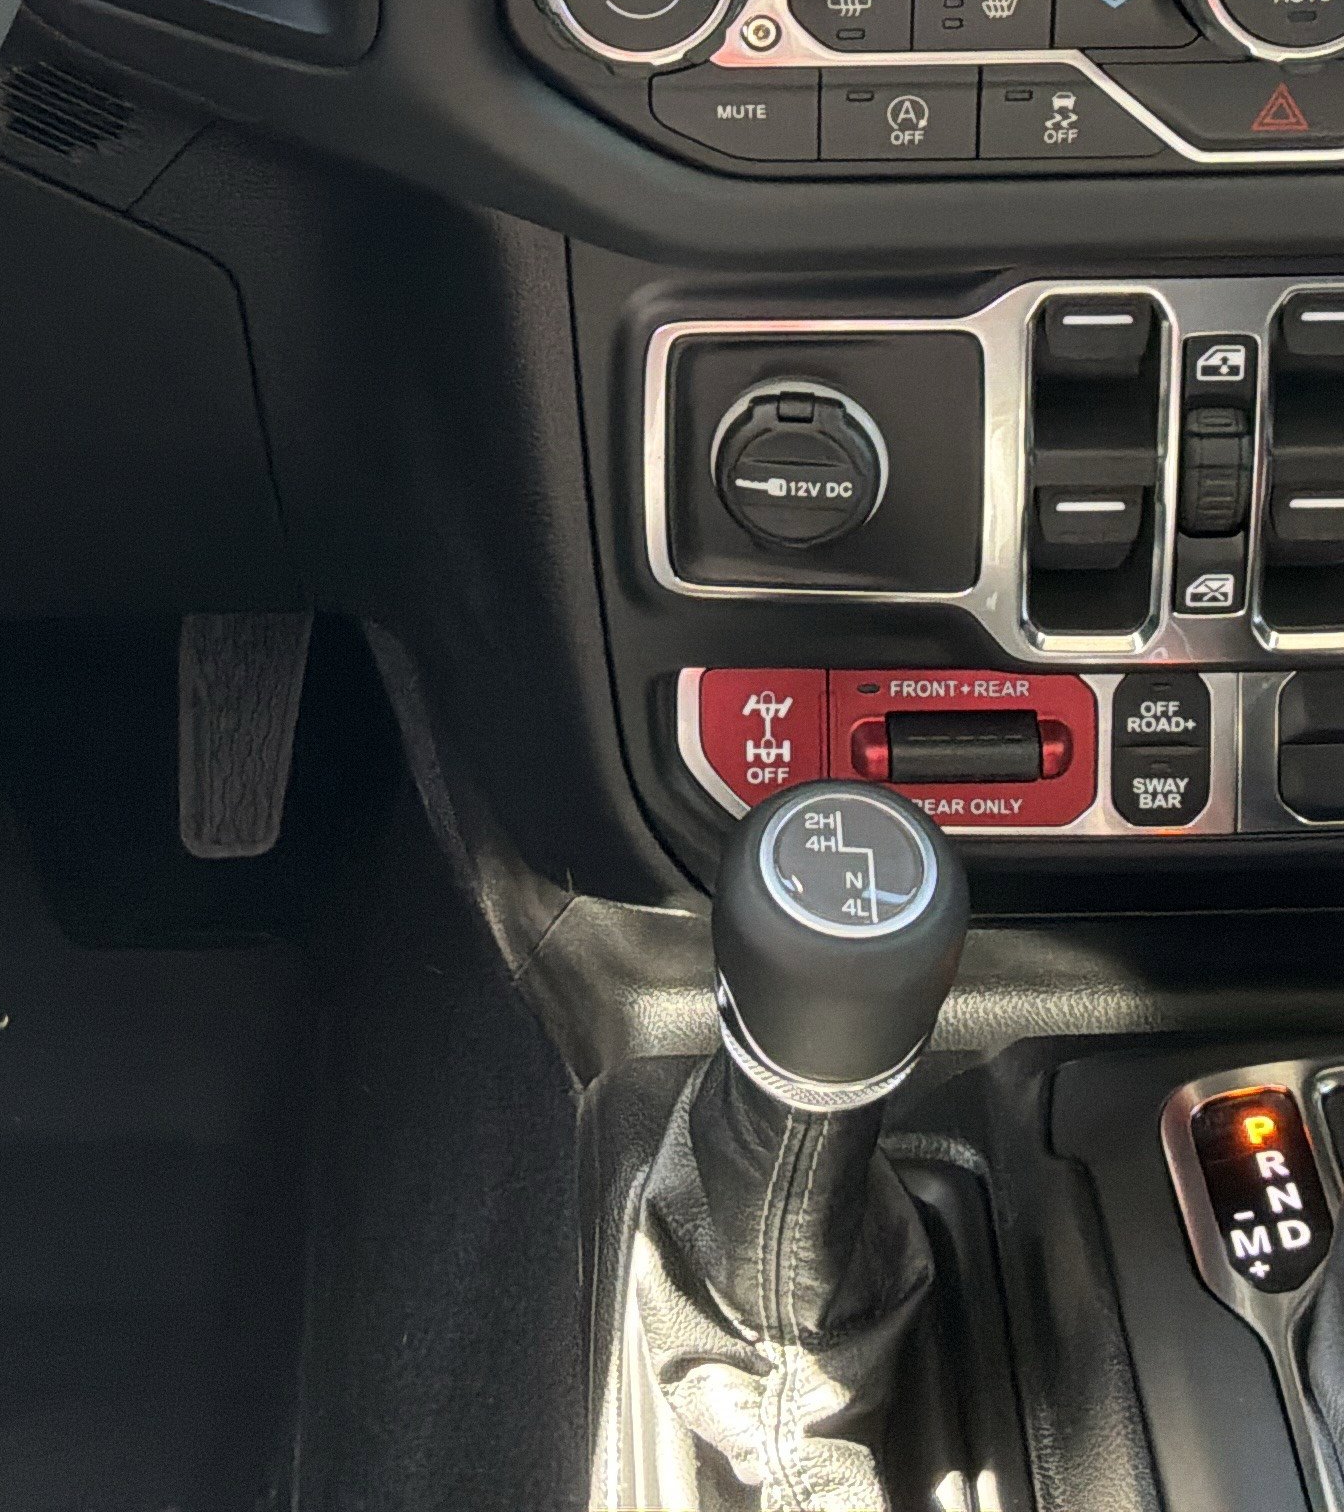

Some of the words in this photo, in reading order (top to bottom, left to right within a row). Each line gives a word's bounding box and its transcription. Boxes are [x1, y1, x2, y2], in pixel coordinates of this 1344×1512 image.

[716, 104, 767, 119] MUTE
[890, 130, 925, 146] OFF
[1043, 129, 1079, 145] OFF
[788, 481, 822, 498] 12V
[826, 481, 853, 498] DC
[1140, 701, 1180, 717] OFF
[1126, 716, 1196, 733] ROAD+
[746, 766, 790, 784] OFF
[1132, 777, 1189, 794] SWAY
[970, 798, 1023, 815] ONLY
[1138, 793, 1182, 809] BAR
[804, 813, 835, 831] 2H
[805, 836, 838, 853] 4H
[845, 873, 863, 888] N
[842, 899, 869, 917] 4L
[1243, 1115, 1276, 1144] P
[1256, 1150, 1290, 1178] R
[1266, 1182, 1303, 1214] N
[1230, 1226, 1273, 1259] M
[1277, 1220, 1311, 1249] D
